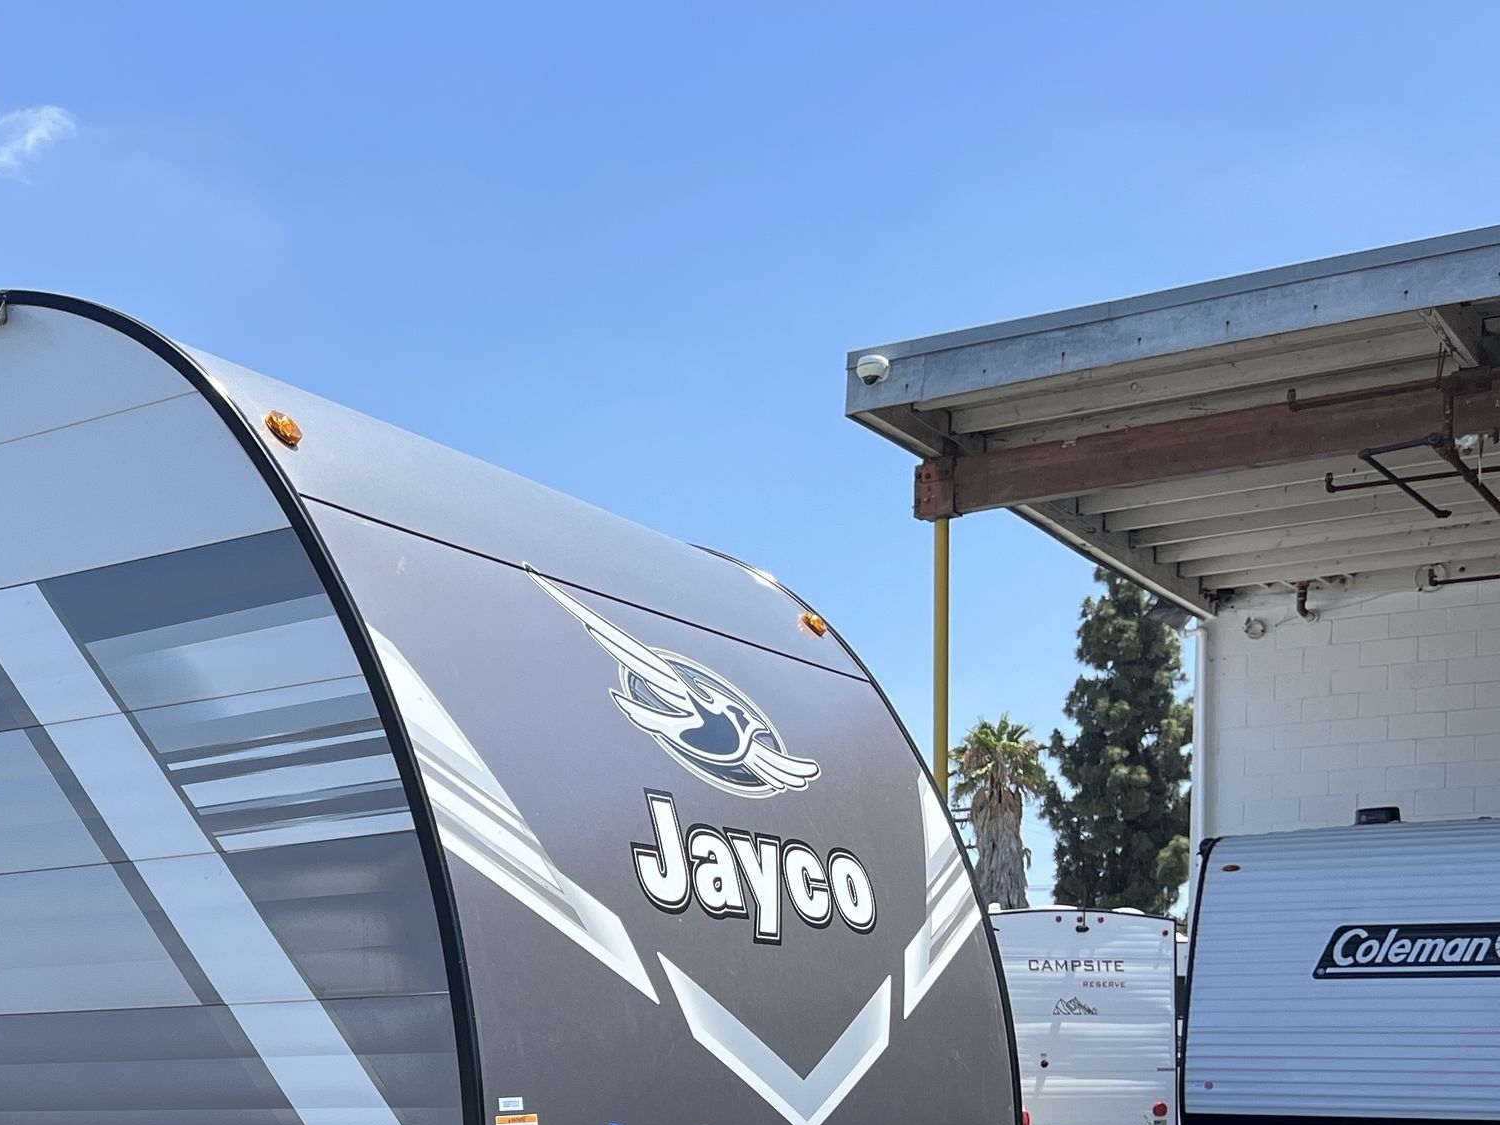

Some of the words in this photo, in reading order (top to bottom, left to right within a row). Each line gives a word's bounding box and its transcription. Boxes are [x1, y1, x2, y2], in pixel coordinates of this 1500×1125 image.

[630, 787, 876, 945] Jayco
[1333, 928, 1491, 966] Coleman
[1028, 959, 1125, 972] CAMPSITE
[1082, 980, 1126, 988] RESERVE
